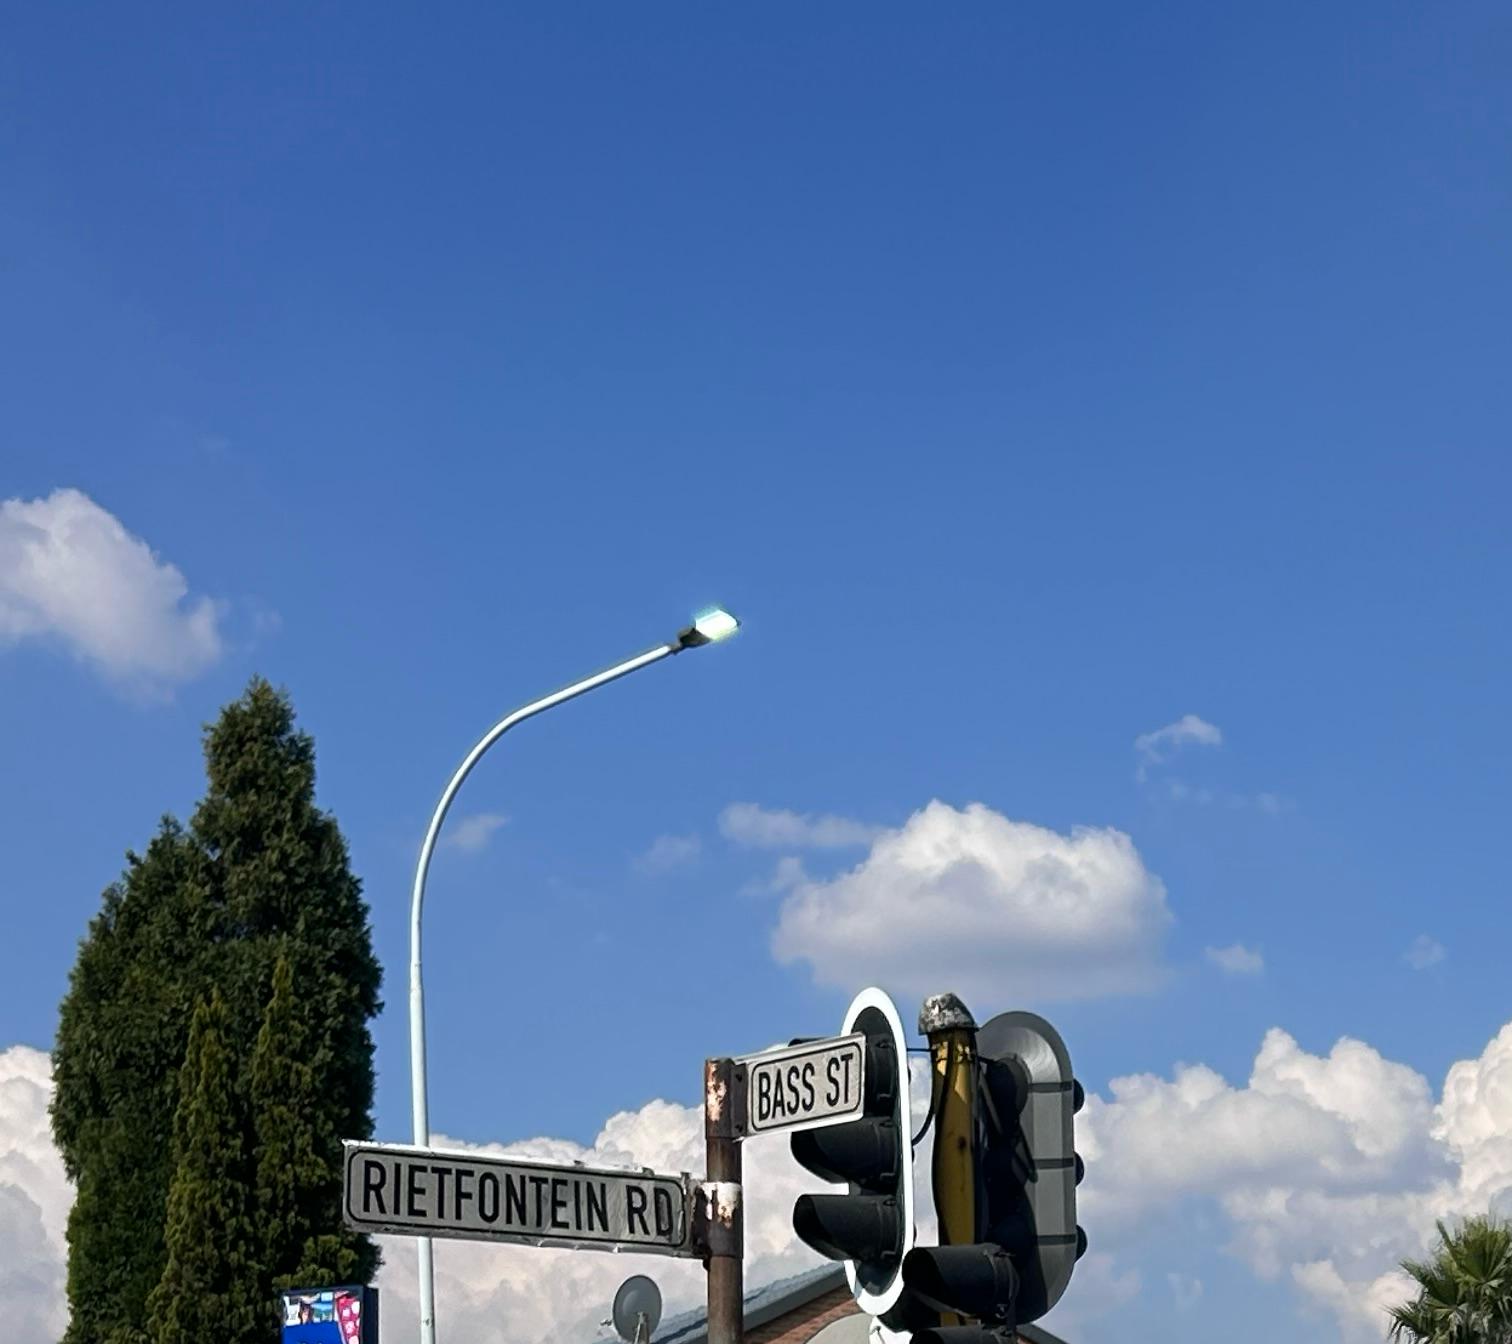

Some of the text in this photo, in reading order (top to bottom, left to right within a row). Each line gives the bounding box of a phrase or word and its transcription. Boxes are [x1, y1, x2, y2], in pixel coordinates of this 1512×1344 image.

[758, 1052, 853, 1121] BASS ST
[363, 1159, 675, 1236] RIETFONTEIN RD
